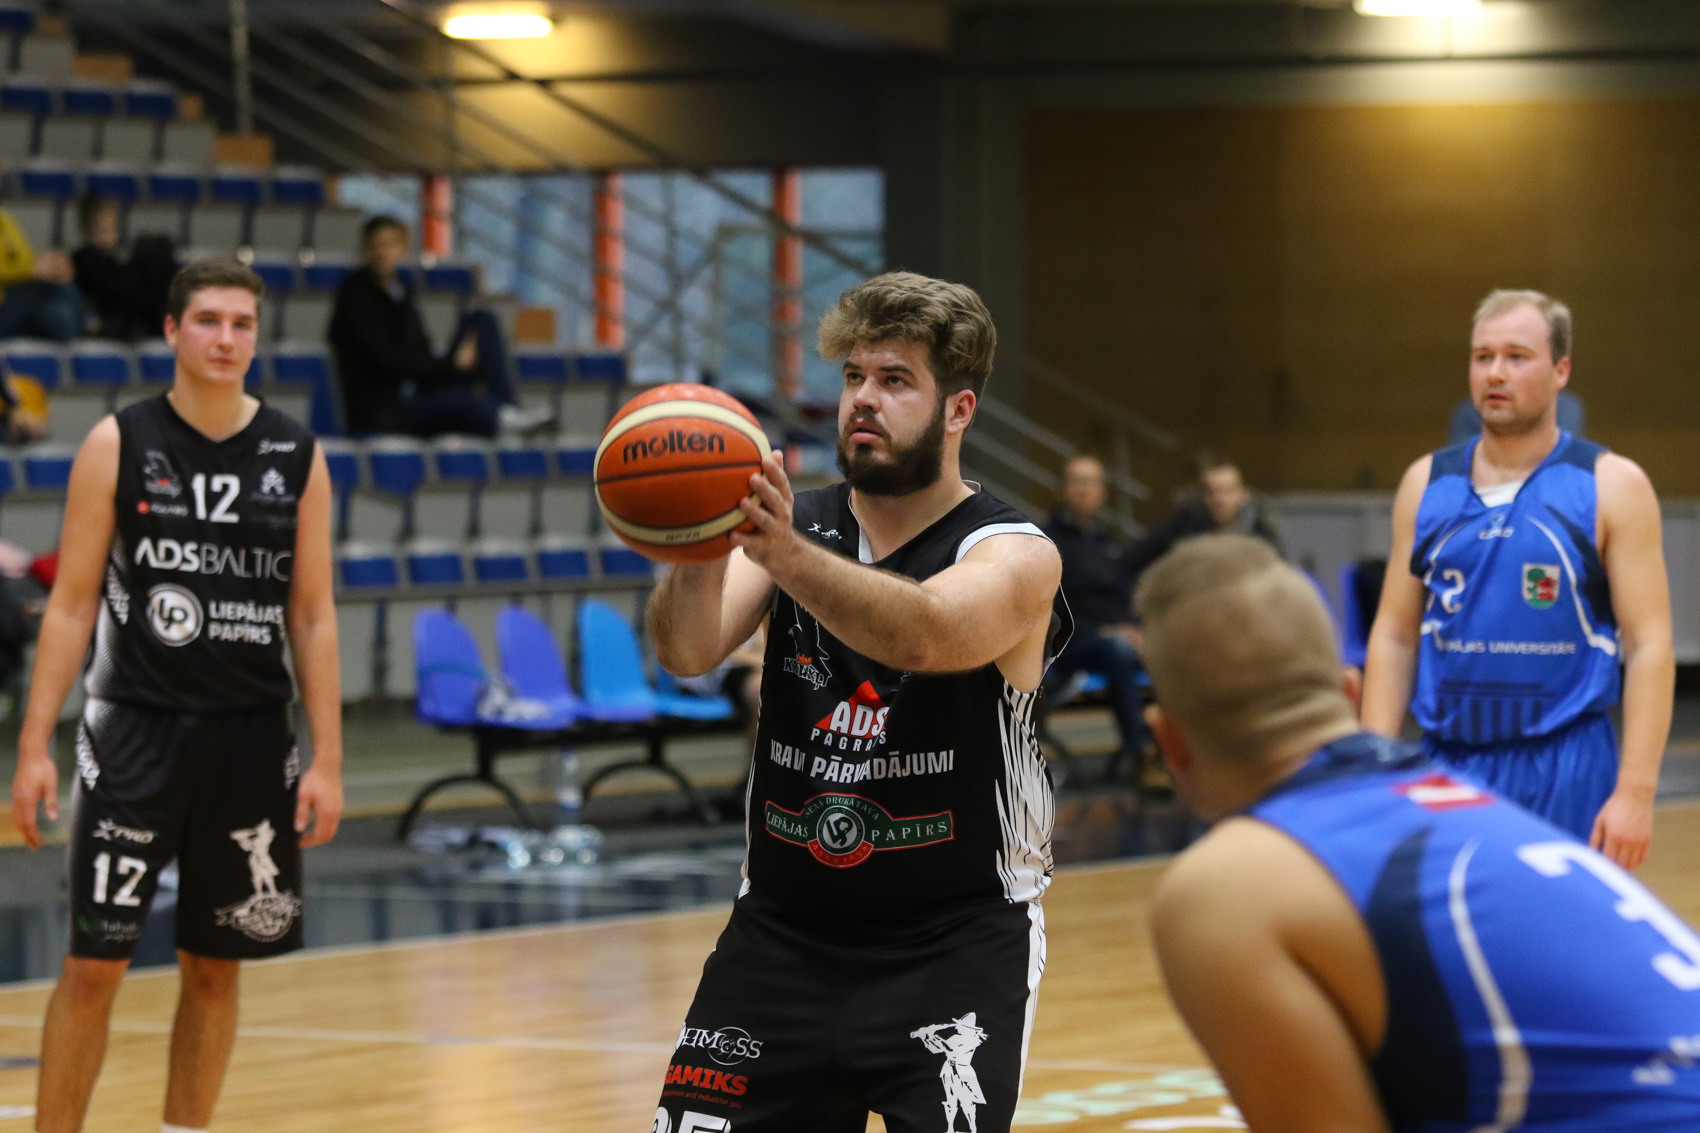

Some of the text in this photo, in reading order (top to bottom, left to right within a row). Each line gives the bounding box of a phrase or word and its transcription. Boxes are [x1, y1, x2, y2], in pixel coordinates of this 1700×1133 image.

[623, 430, 725, 464] molten
[192, 473, 241, 523] 12
[829, 701, 890, 737] ADS
[810, 750, 954, 784] PĀRVADĀJUMI
[766, 811, 808, 839] LIEPĀJAS
[871, 821, 948, 842] PAPĪRS
[93, 852, 148, 907] 12
